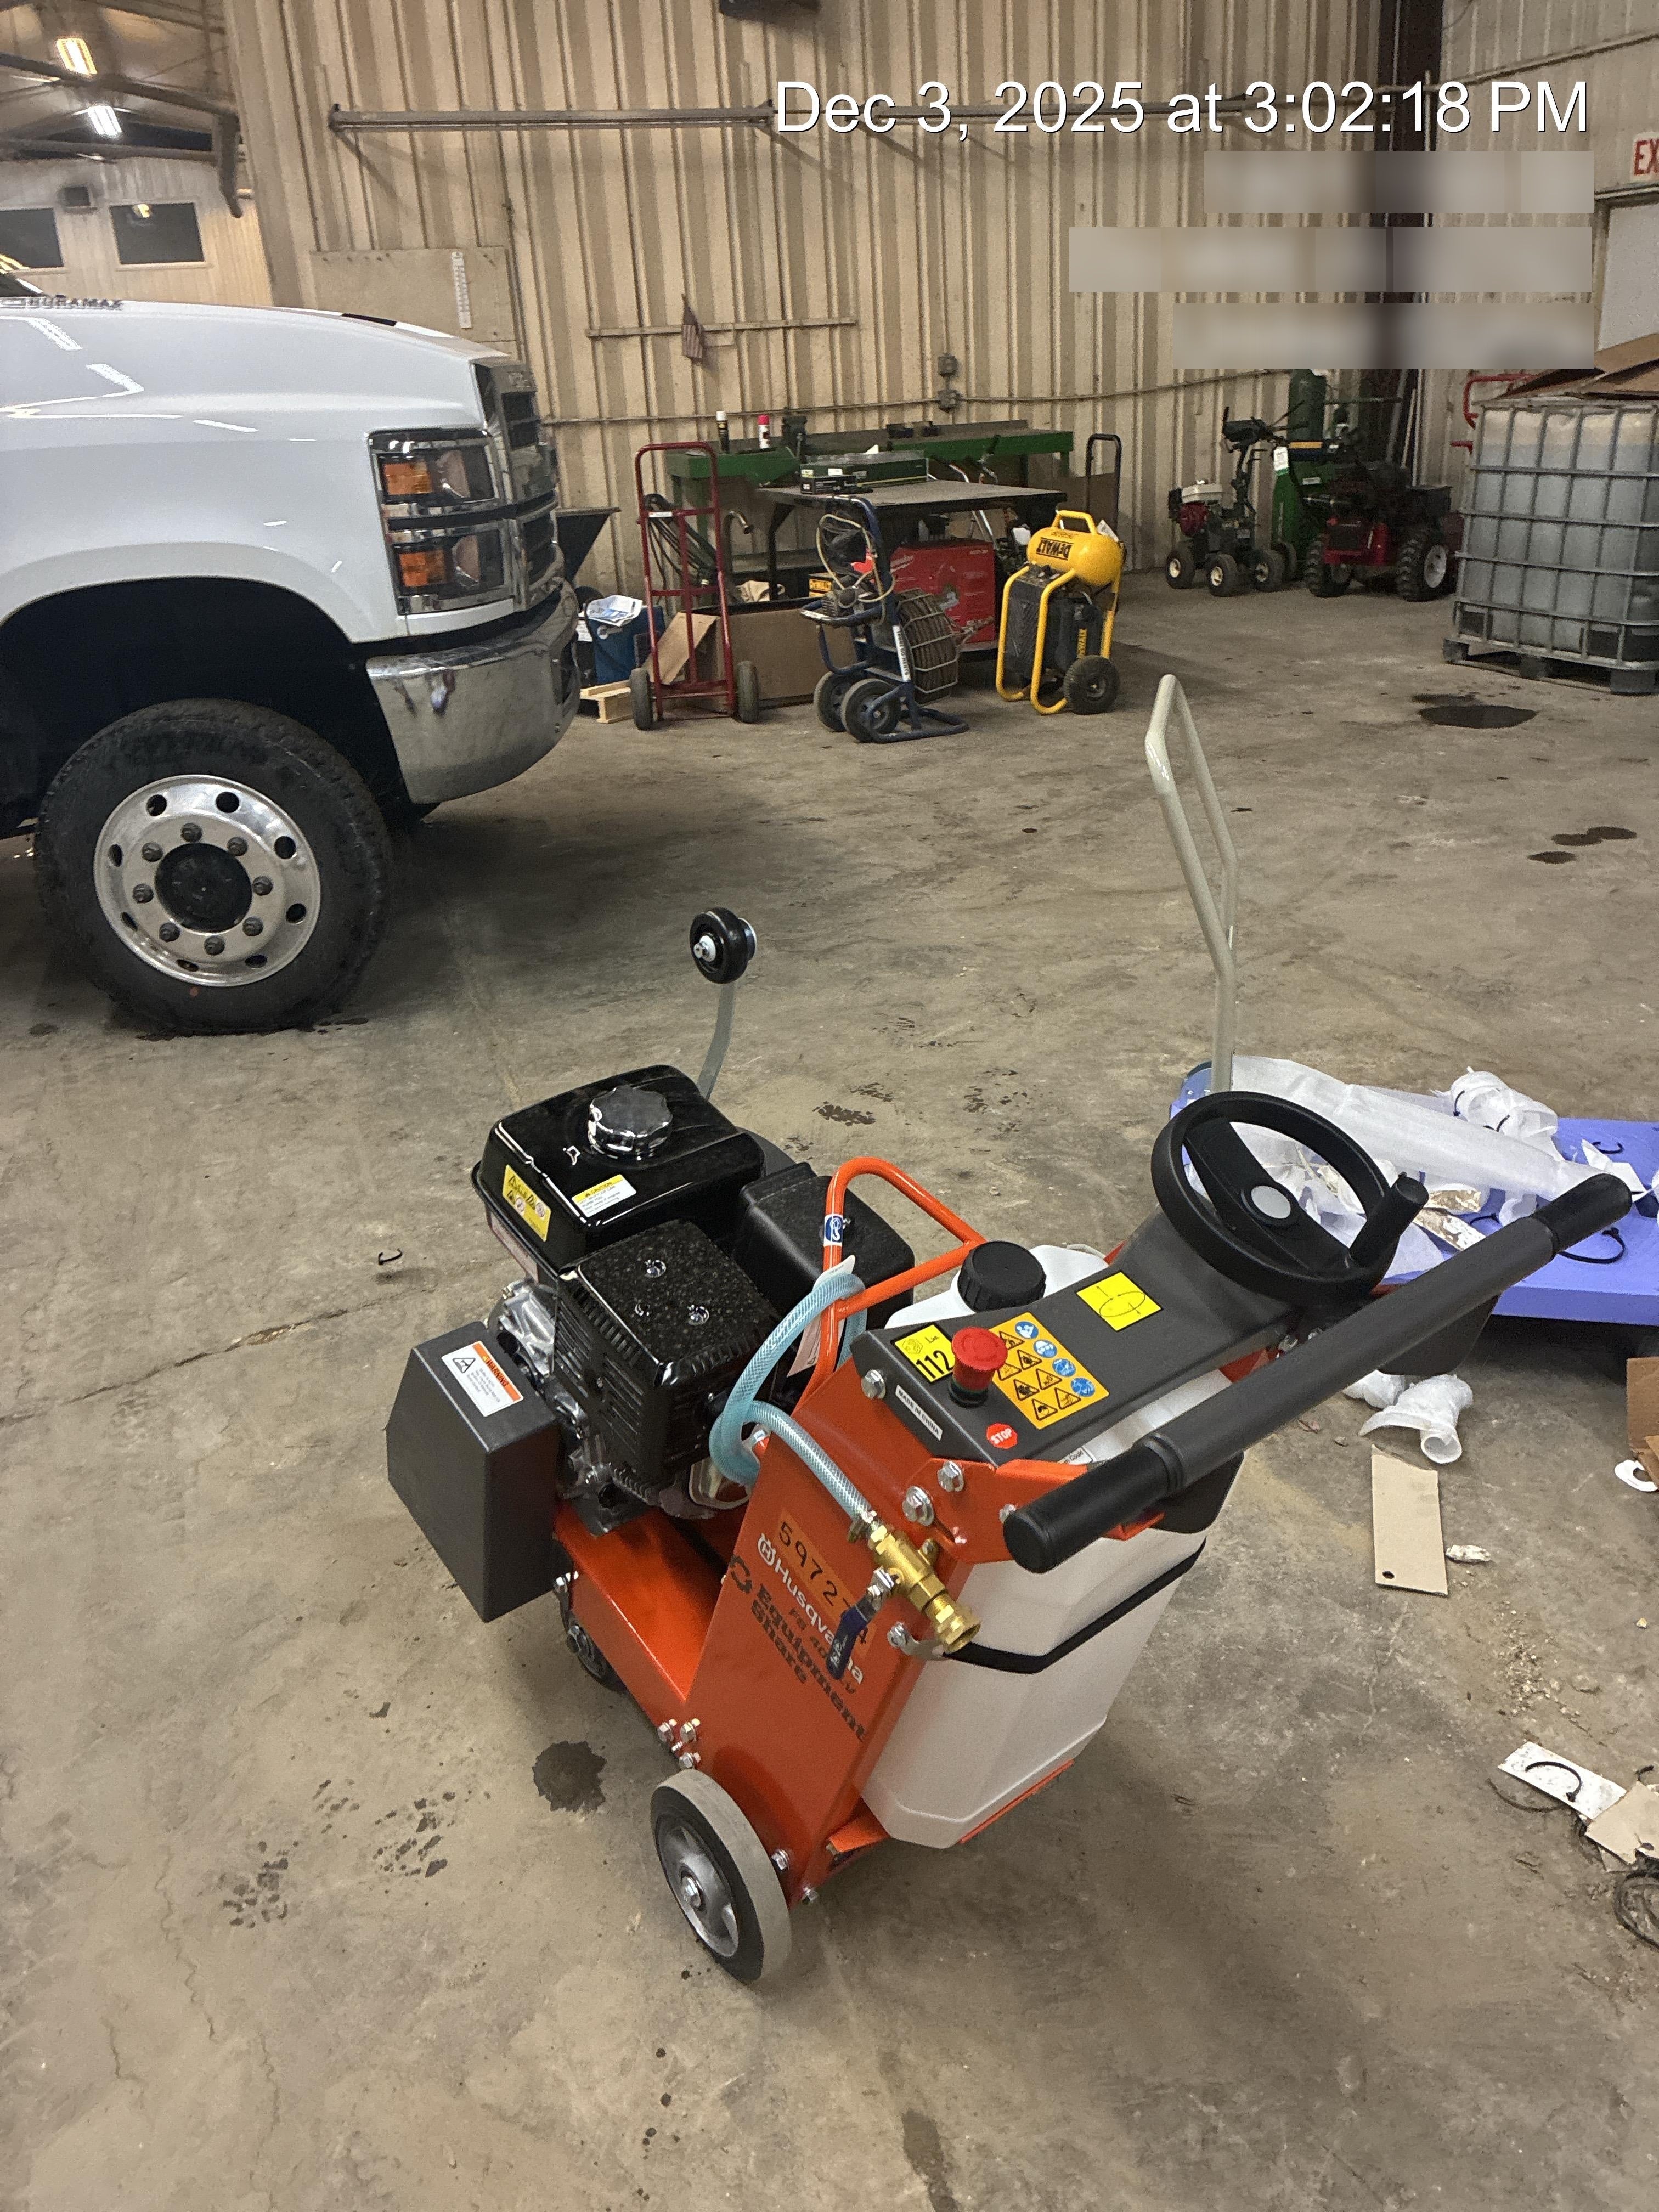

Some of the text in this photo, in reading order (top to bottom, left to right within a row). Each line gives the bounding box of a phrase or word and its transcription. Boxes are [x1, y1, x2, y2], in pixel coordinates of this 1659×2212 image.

[486, 1359, 510, 1387] WARNING
[916, 1350, 955, 1379] 112
[898, 1390, 939, 1435] MADE IN CHINA
[990, 1427, 1012, 1444] STOP
[751, 1600, 807, 1684] Share
[774, 1558, 863, 1685] Husqvaa
[757, 1583, 865, 1742] Equipment
